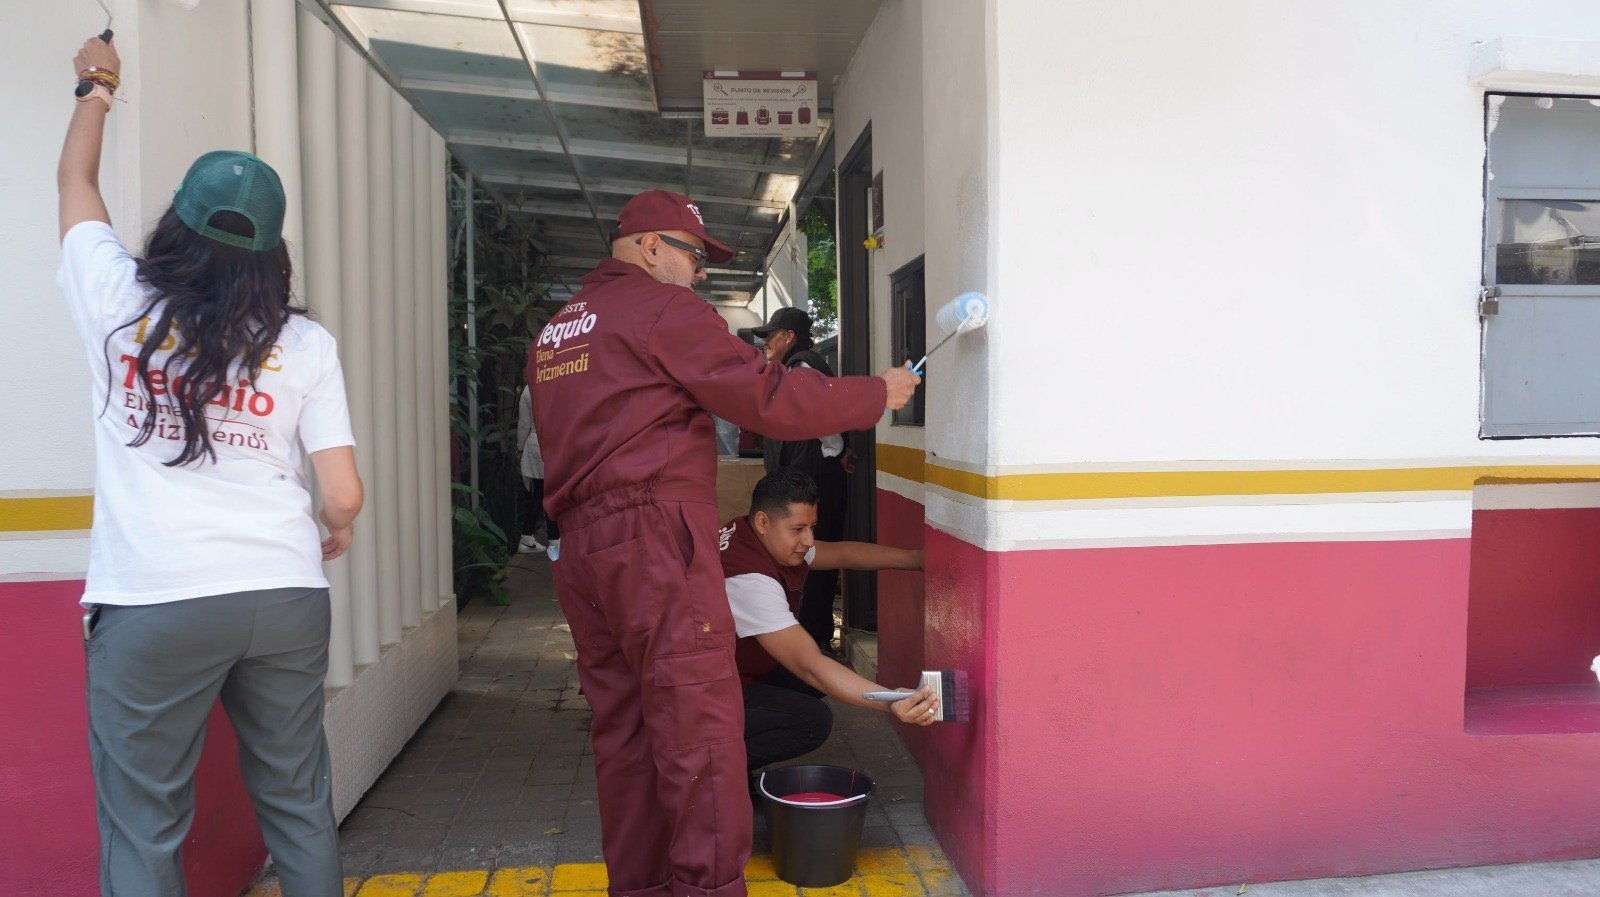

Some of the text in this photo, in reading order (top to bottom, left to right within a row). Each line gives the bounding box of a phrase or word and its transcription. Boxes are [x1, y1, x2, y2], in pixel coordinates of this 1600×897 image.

[762, 86, 791, 94] REVISIÓN
[536, 349, 554, 363] Elena
[536, 353, 589, 384] Arizmendi
[126, 413, 269, 451] Arizendi
